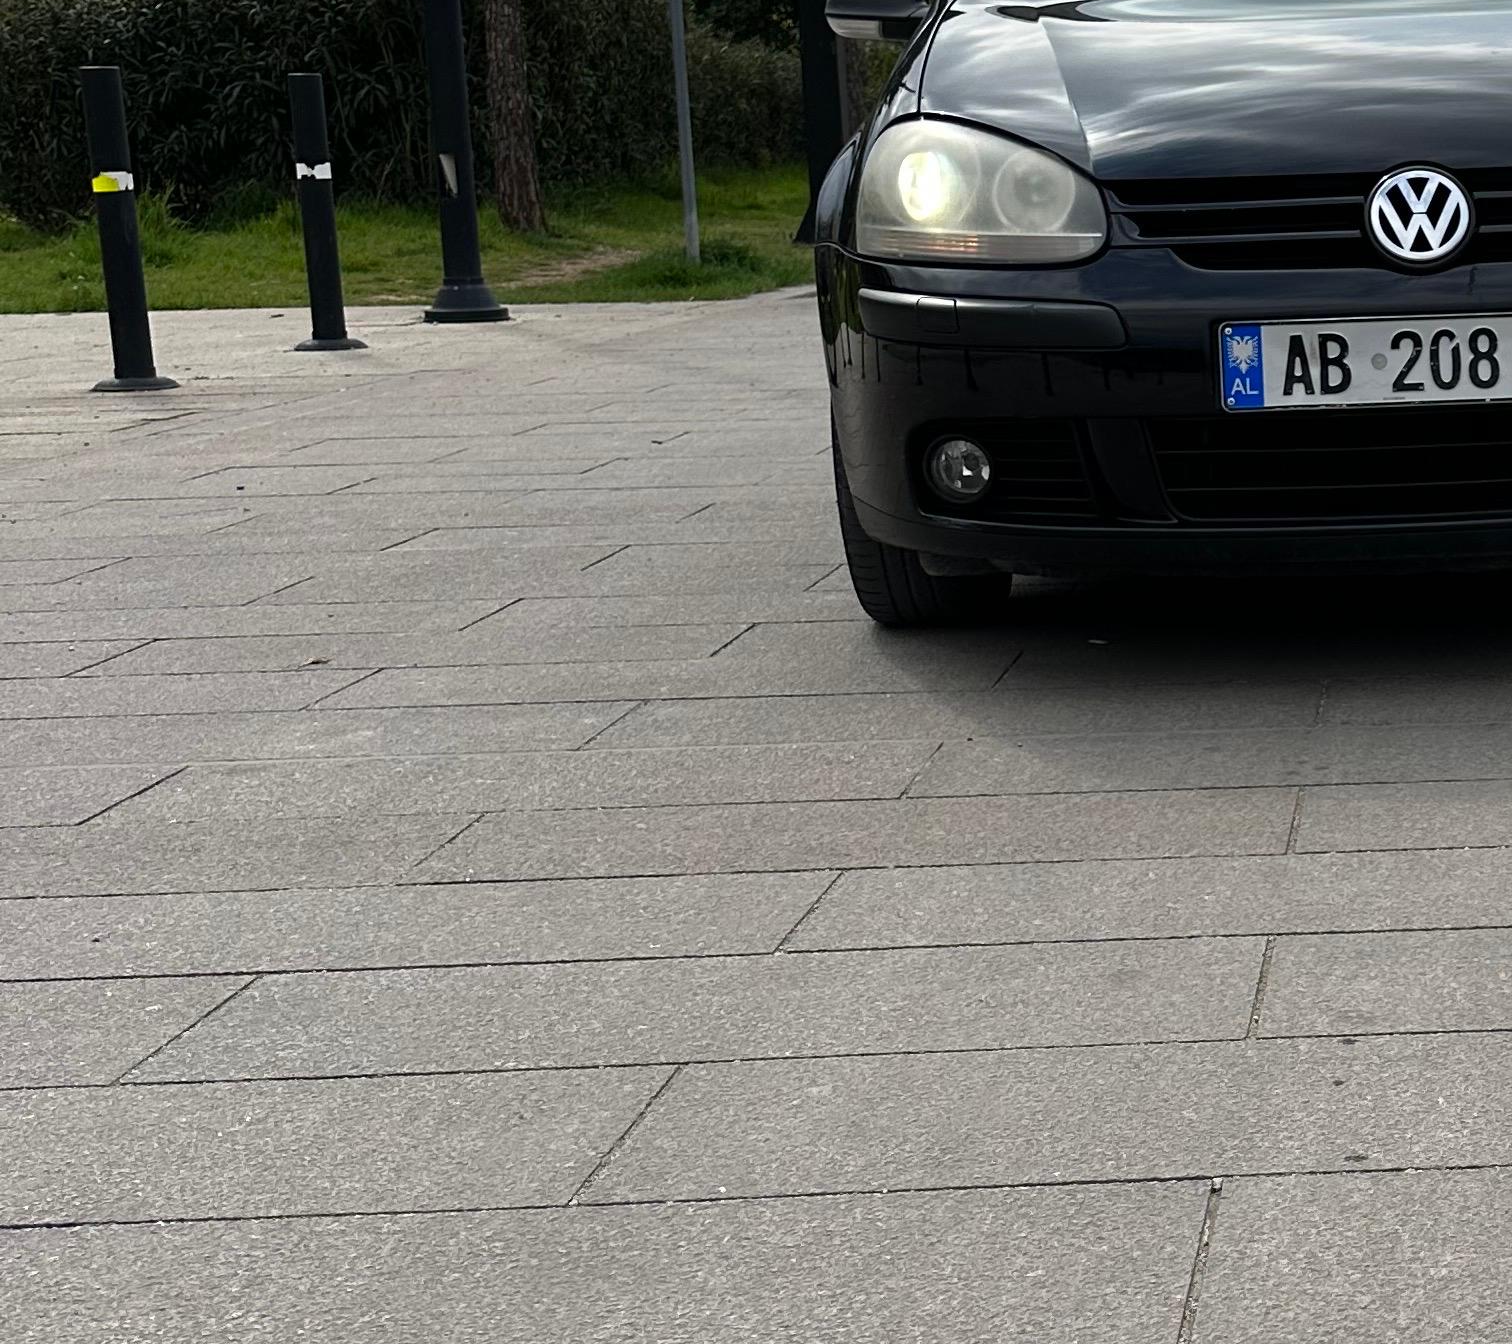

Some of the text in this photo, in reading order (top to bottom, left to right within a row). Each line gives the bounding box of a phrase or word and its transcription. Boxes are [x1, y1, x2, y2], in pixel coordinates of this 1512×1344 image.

[1371, 170, 1469, 259] VW
[1231, 377, 1260, 395] AL
[1283, 333, 1352, 396] AB
[1391, 327, 1500, 393] 208
